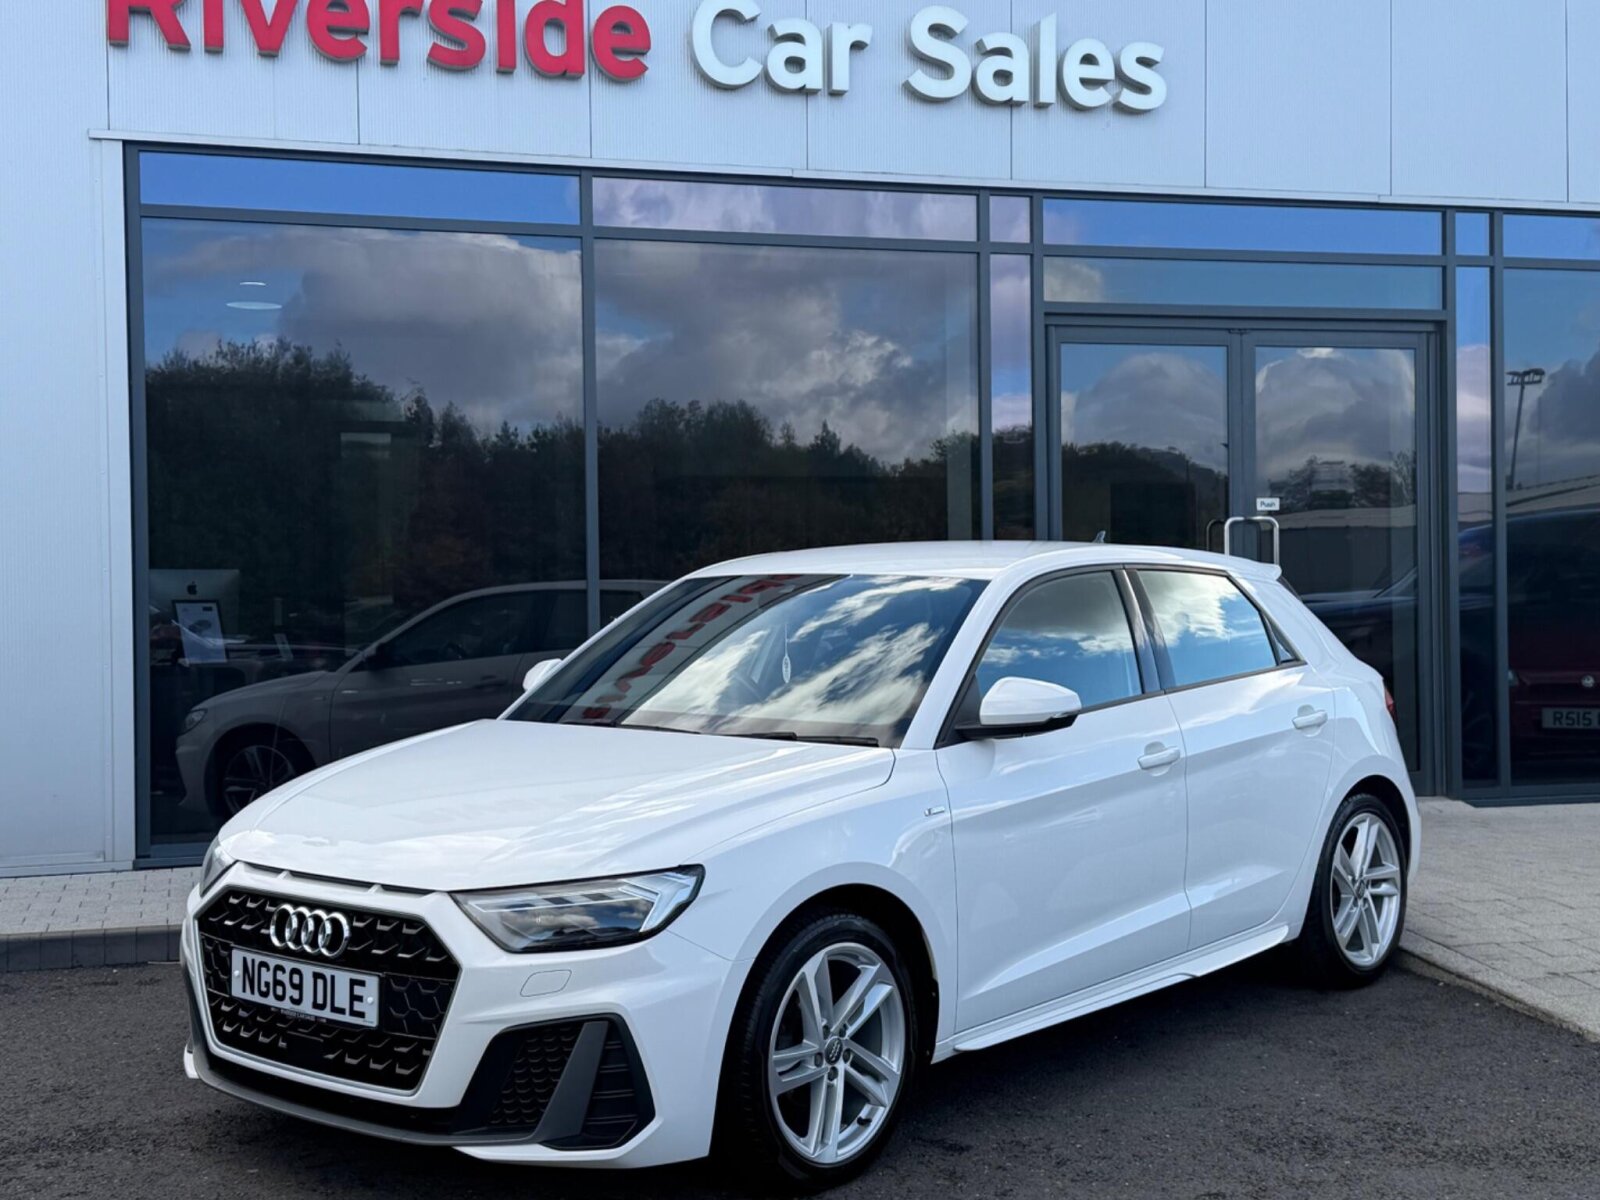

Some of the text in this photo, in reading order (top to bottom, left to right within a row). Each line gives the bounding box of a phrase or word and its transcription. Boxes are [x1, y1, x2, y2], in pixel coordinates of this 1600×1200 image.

[690, 0, 872, 96] Car
[903, 6, 1167, 114] Sales
[1260, 500, 1276, 508] Push
[1552, 710, 1593, 727] RS15
[242, 956, 367, 1019] NG69 DLE
